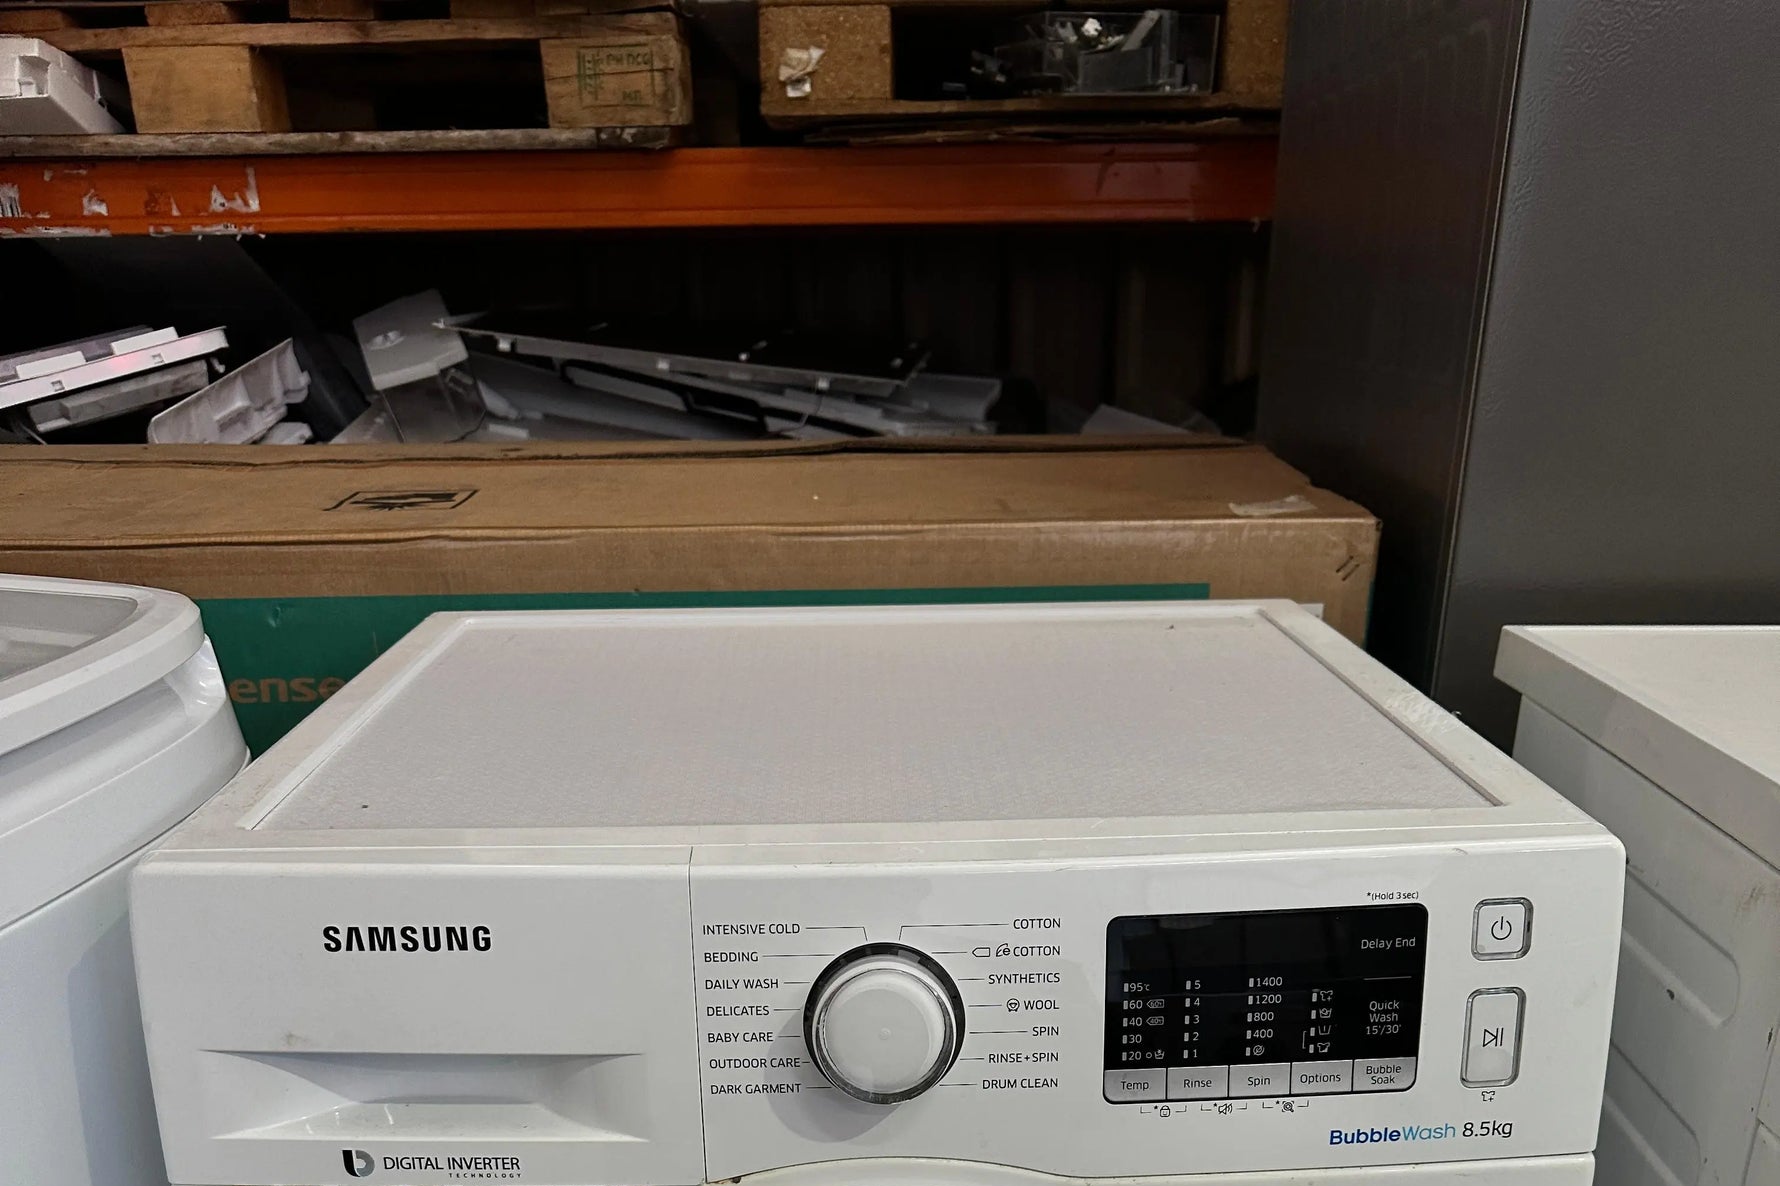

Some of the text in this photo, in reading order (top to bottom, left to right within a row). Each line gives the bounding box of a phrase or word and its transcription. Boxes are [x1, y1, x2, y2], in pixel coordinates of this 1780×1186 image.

[229, 677, 346, 702] ense
[703, 923, 800, 935] INTENSIVE COLD
[1013, 918, 1061, 929] COTTON
[323, 926, 491, 952] SAMSUNG
[1361, 937, 1416, 950] Delay End
[1013, 945, 1061, 957] COTTON
[704, 951, 758, 963] BEDDING
[988, 972, 1061, 984] SYNTHETICS
[1256, 976, 1283, 987] 1400
[705, 978, 779, 990] DAILY WASH
[1194, 980, 1201, 990] 5
[1023, 999, 1060, 1010] WOOL
[1129, 1000, 1143, 1009] 60
[1193, 998, 1200, 1007] 4
[1255, 994, 1282, 1005] 1200
[706, 1005, 770, 1017] DELICATES
[1369, 1001, 1400, 1012] Quick
[1129, 1017, 1143, 1027] 40
[1193, 1015, 1200, 1024] 3
[1253, 1012, 1275, 1022] 800
[1369, 1013, 1399, 1023] Wash
[1032, 1025, 1060, 1037] SPIN
[1192, 1032, 1199, 1041] 2
[1253, 1029, 1274, 1039] 400
[707, 1031, 774, 1043] BABY CARE
[1128, 1034, 1142, 1043] 30
[1128, 1051, 1142, 1061] 20
[1193, 1050, 1198, 1058] 1
[709, 1057, 801, 1069] OUTDOOR CARE
[1366, 1064, 1402, 1075] Bubble
[982, 1077, 1058, 1089] DRUM CLEAN
[1183, 1077, 1212, 1088] Rinse
[1247, 1075, 1271, 1087] Spin
[1300, 1072, 1341, 1085] Options
[1371, 1075, 1396, 1085] Soak
[710, 1083, 801, 1094] DARK GARMENT
[1121, 1080, 1150, 1092] Temp
[1462, 1120, 1513, 1138] 8.5kg
[383, 1156, 521, 1170] DIGITAL INVERTER
